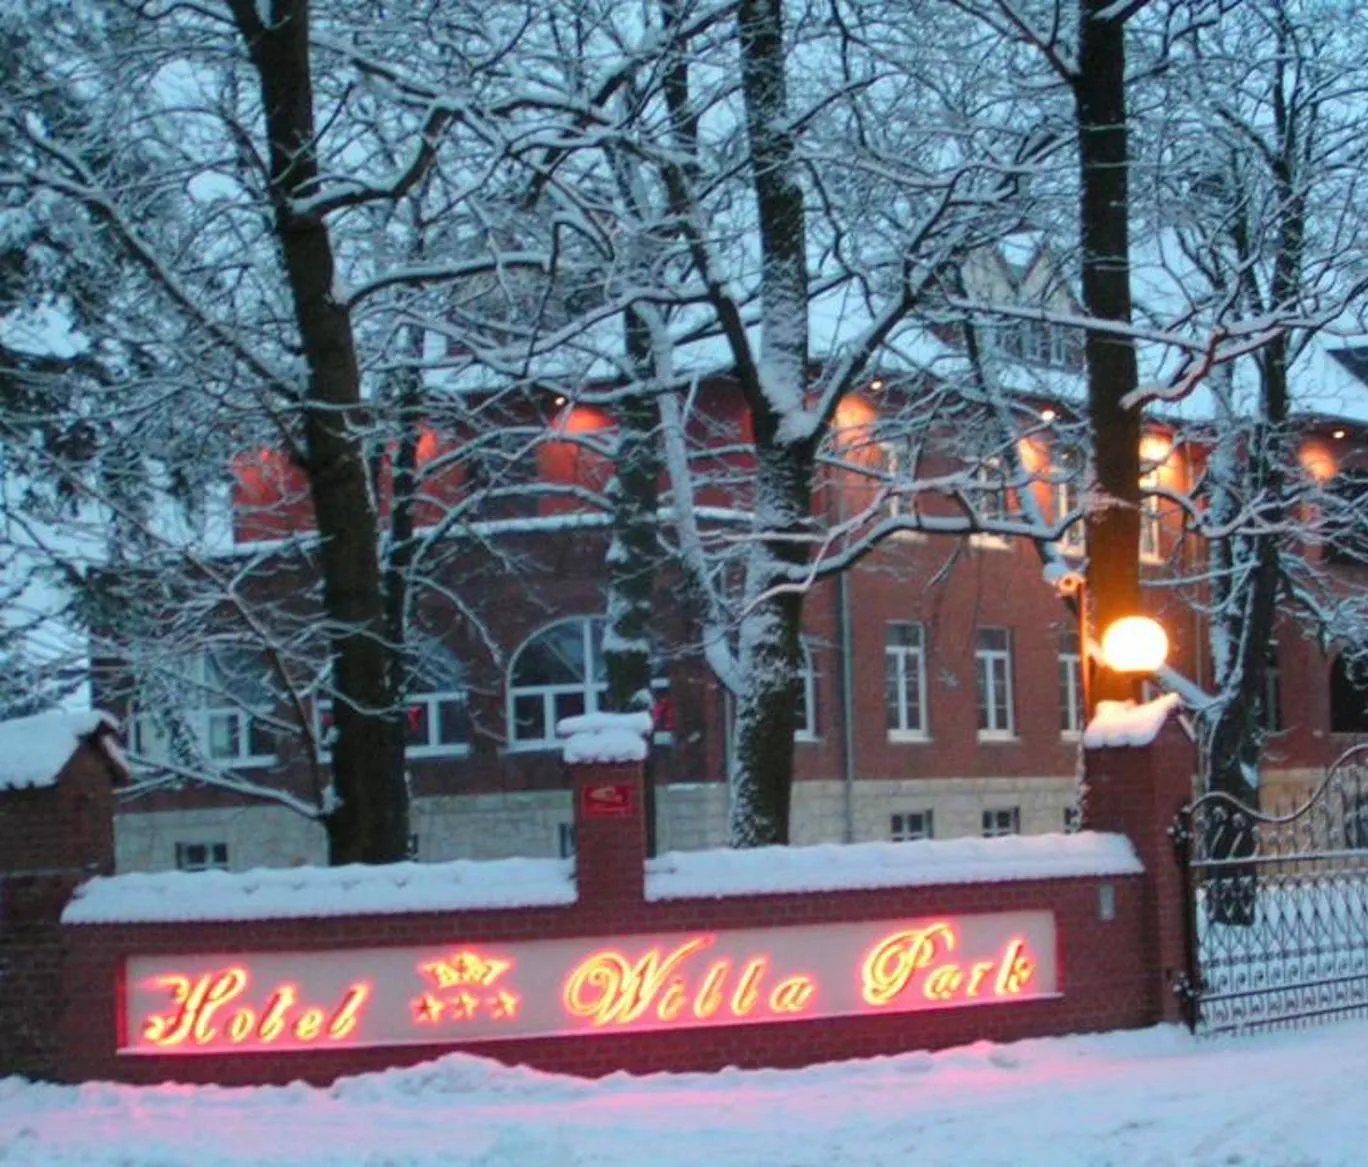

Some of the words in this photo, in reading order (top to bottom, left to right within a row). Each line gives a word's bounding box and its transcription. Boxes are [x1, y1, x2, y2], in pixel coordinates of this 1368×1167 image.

[141, 964, 371, 1047] Hotel
[564, 933, 815, 1025] Willa
[862, 921, 1035, 1006] Park
